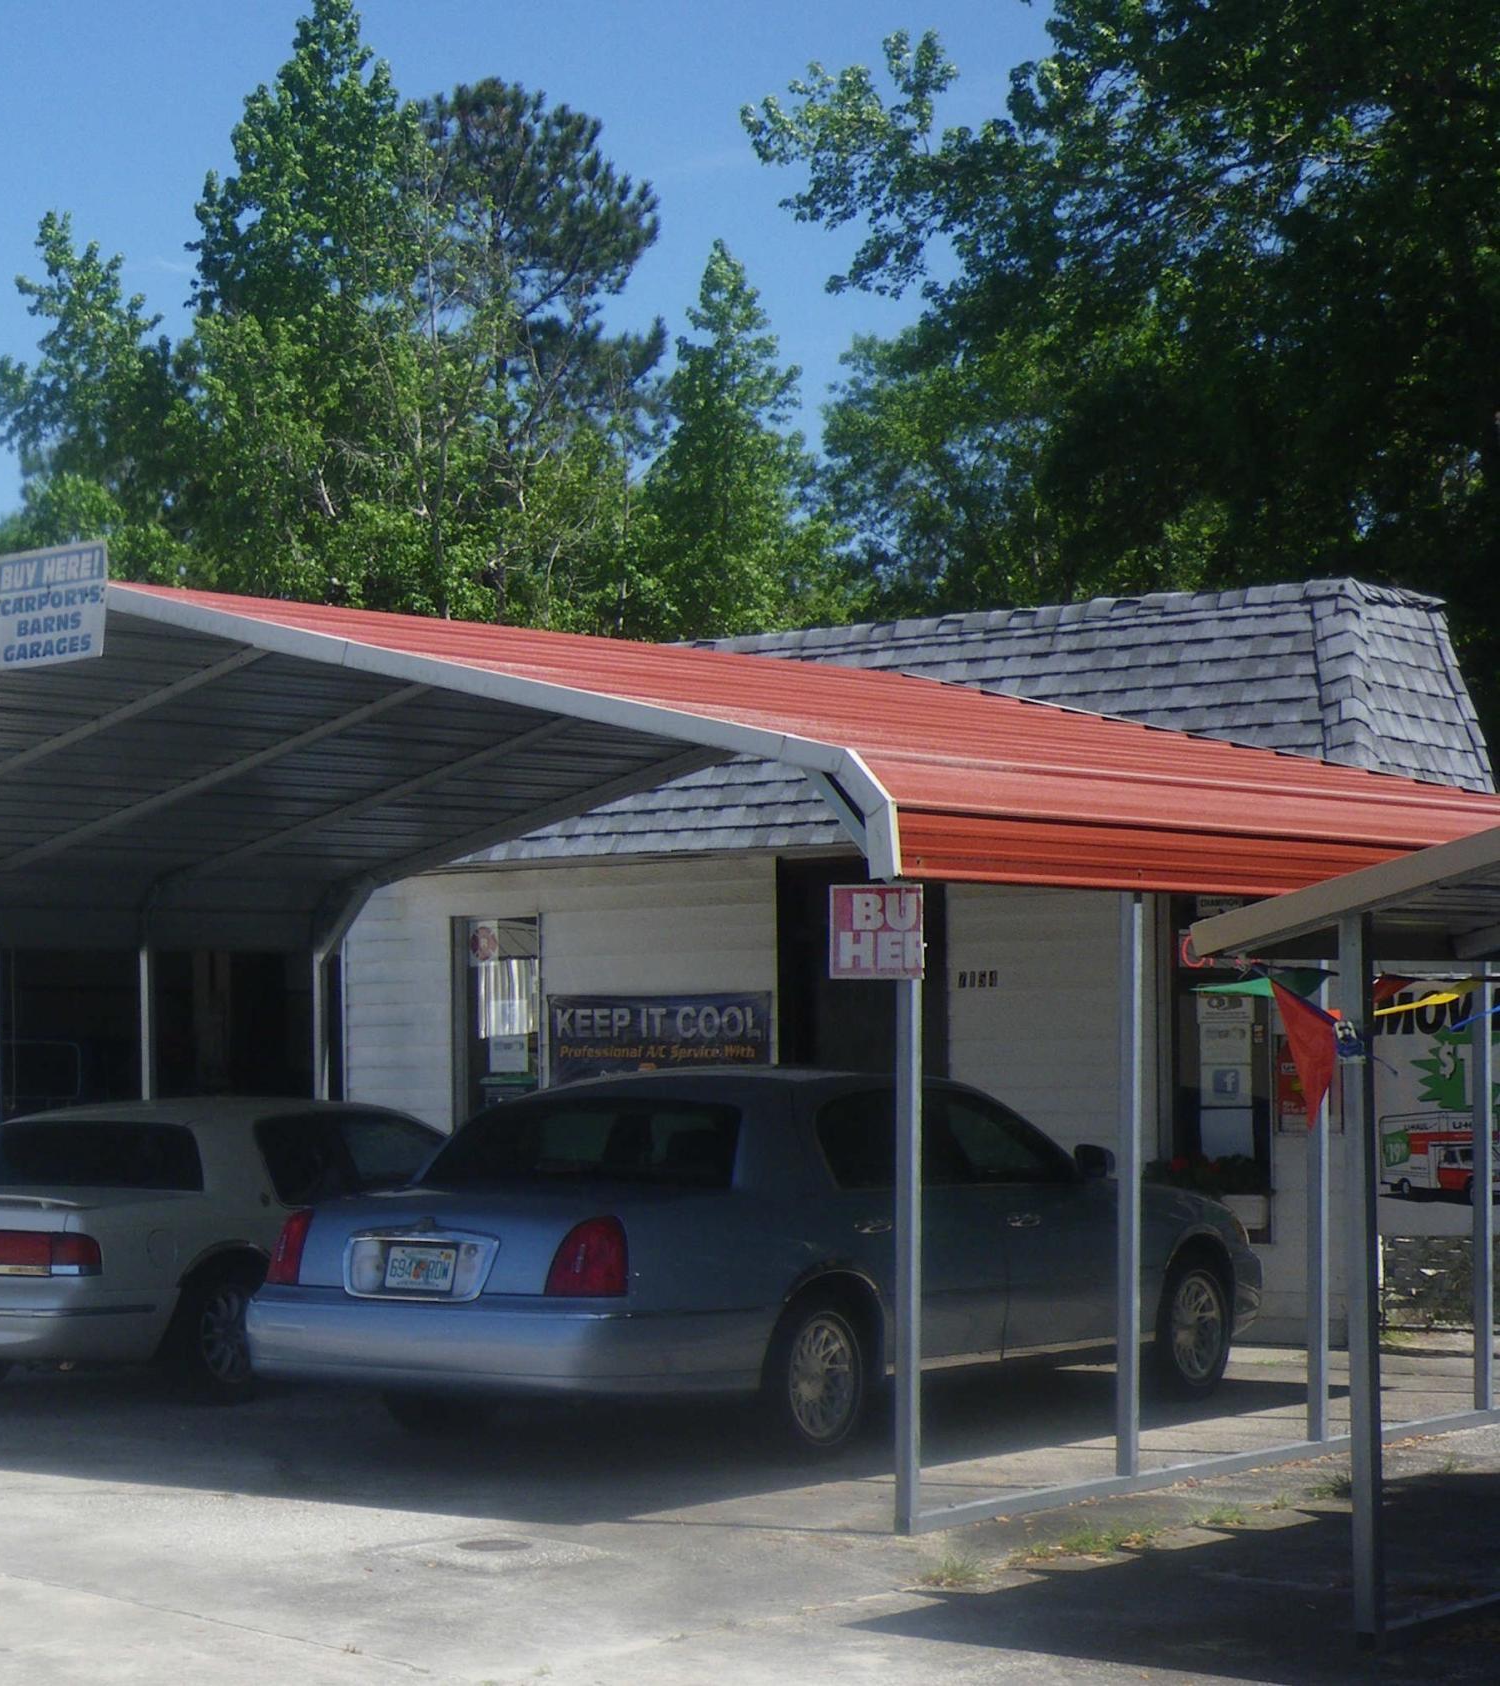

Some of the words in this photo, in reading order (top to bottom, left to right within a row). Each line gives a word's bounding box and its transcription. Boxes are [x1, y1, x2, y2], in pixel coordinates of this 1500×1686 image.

[1, 559, 38, 590] BUY
[42, 550, 100, 586] HERE!
[0, 585, 100, 616] CARPORTS
[17, 611, 82, 637] BARNS
[3, 633, 92, 662] GARAGES
[556, 1007, 631, 1038] KEEP
[640, 1007, 667, 1038] IT
[676, 1005, 760, 1039] COOL
[1374, 987, 1500, 1034] MOV
[559, 1044, 643, 1059] Professional
[646, 1045, 666, 1058] A/C
[723, 1044, 756, 1058] With
